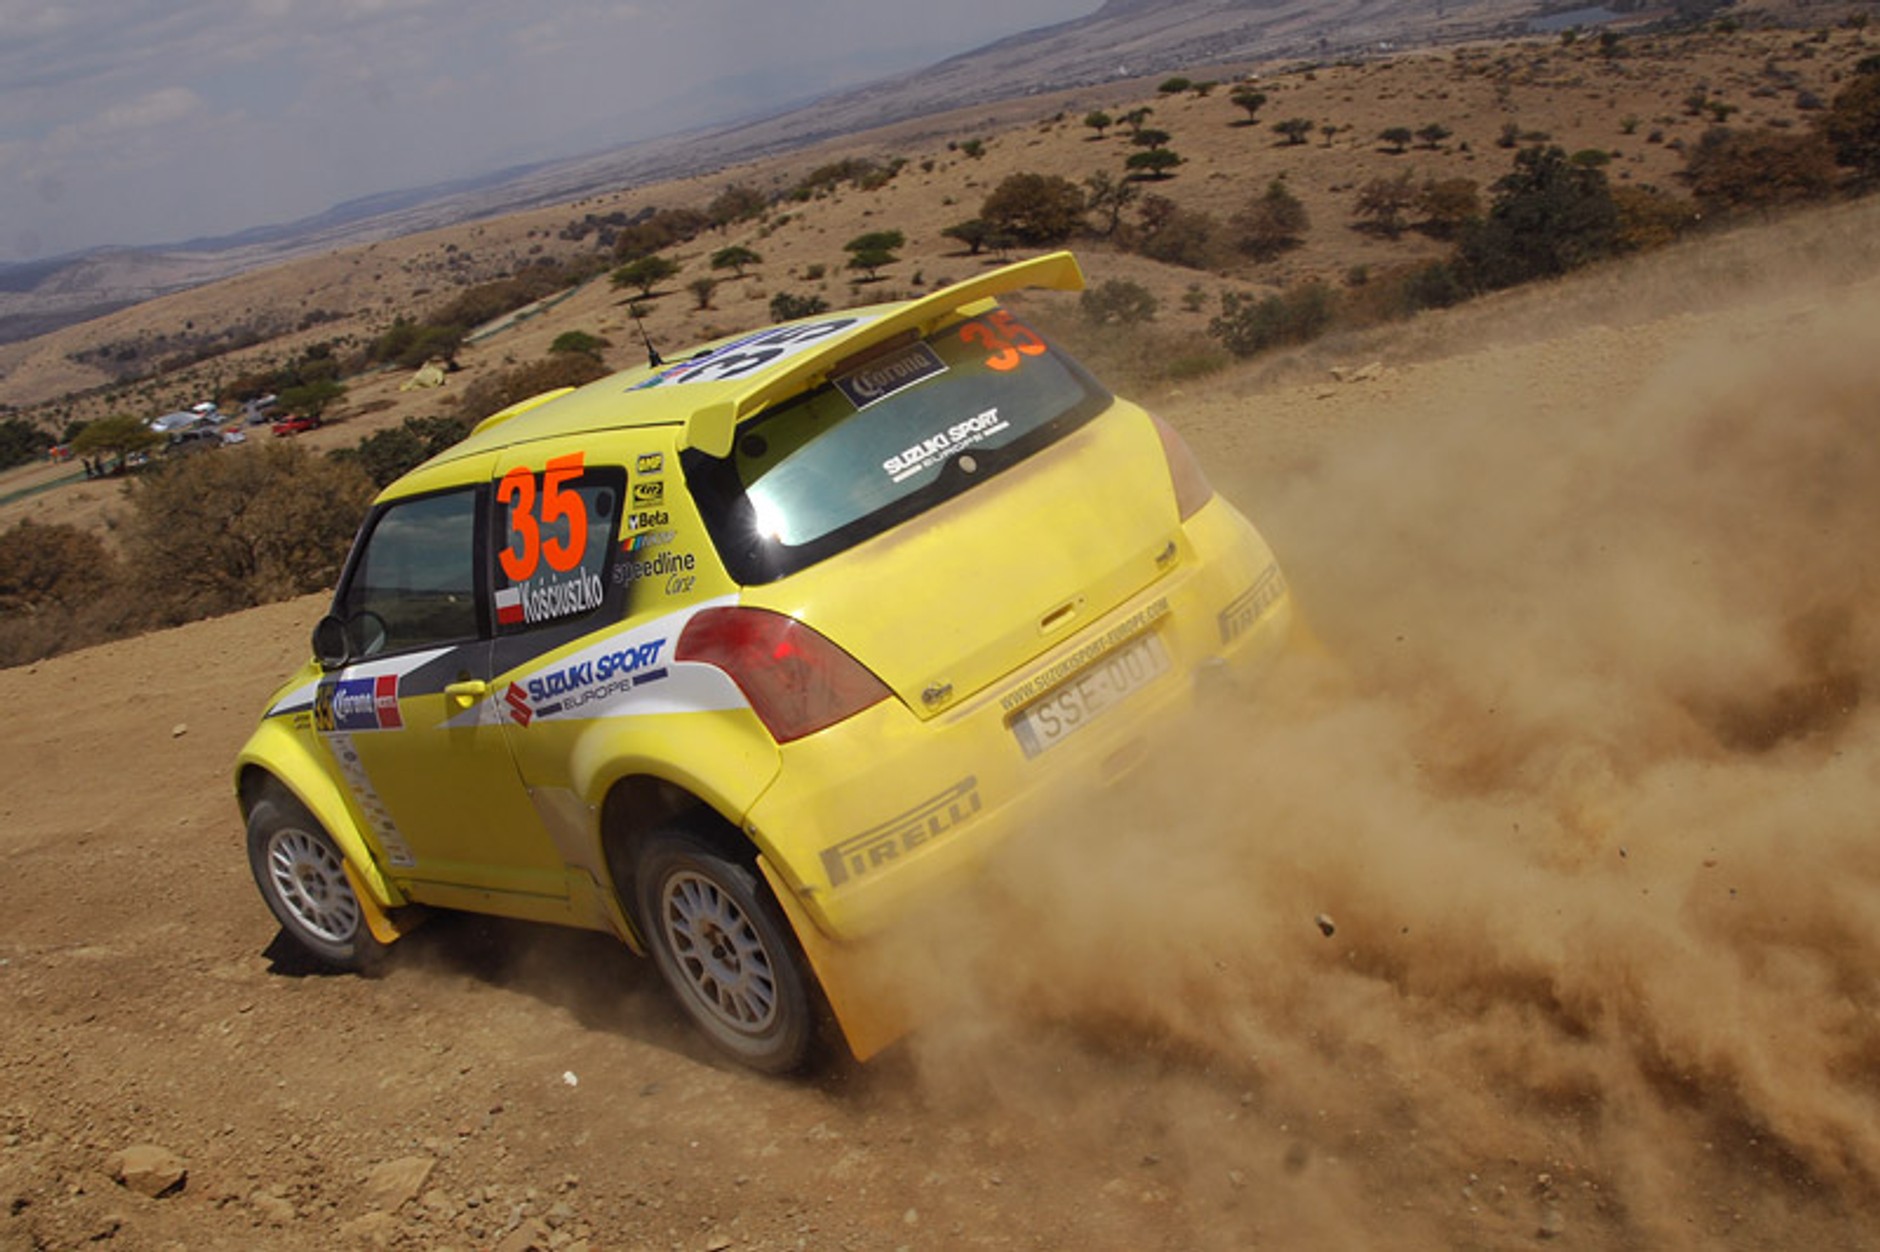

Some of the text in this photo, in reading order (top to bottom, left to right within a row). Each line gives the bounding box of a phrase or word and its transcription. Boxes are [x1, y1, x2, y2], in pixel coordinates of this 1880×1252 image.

[960, 309, 1047, 371] 35
[852, 351, 932, 398] Corona
[883, 407, 998, 475] SUZUKI SPORT
[496, 451, 588, 582] 35
[639, 510, 669, 528] Beta
[518, 566, 603, 624] Kościuszko
[613, 551, 696, 588] speedline
[528, 638, 667, 702] SUZUKI SPORT
[564, 678, 632, 711] EUROPE
[818, 774, 982, 889] PIRELLI
